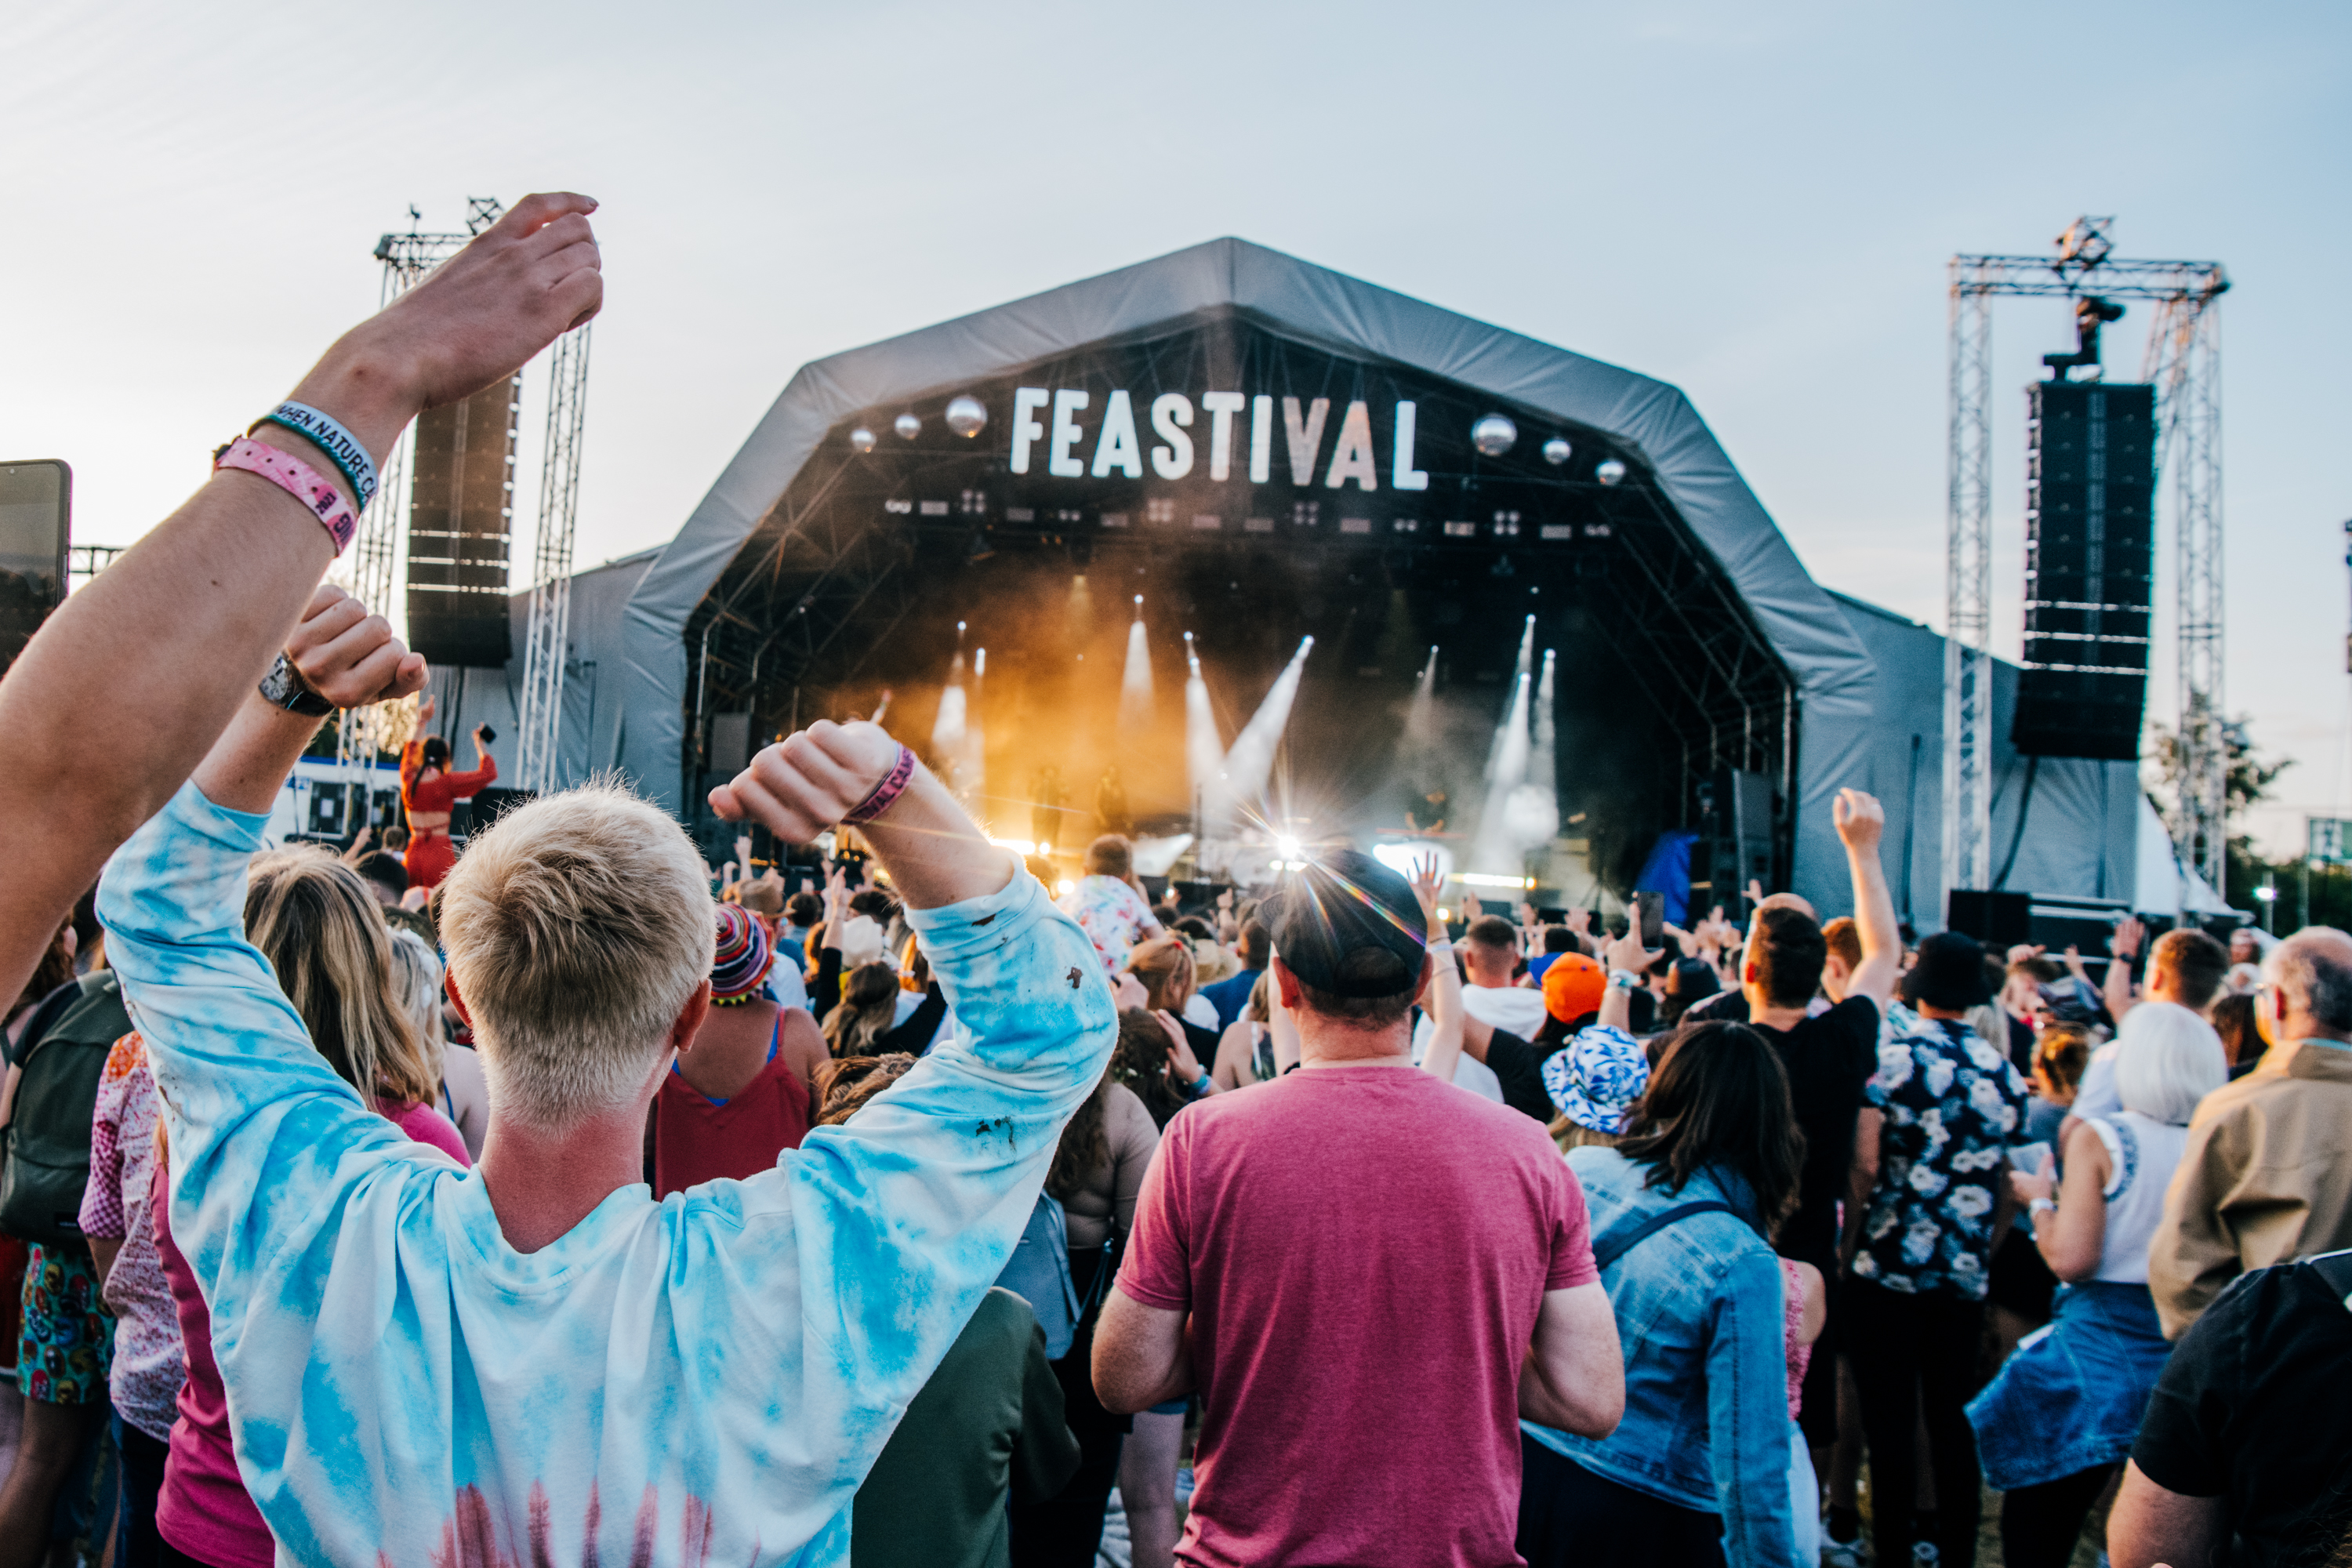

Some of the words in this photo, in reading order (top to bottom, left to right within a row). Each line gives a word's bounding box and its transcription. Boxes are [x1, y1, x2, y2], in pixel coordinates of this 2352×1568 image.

[313, 421, 368, 479] NATURE
[1010, 387, 1428, 492] FEASTIVAL
[315, 491, 338, 515] 2021
